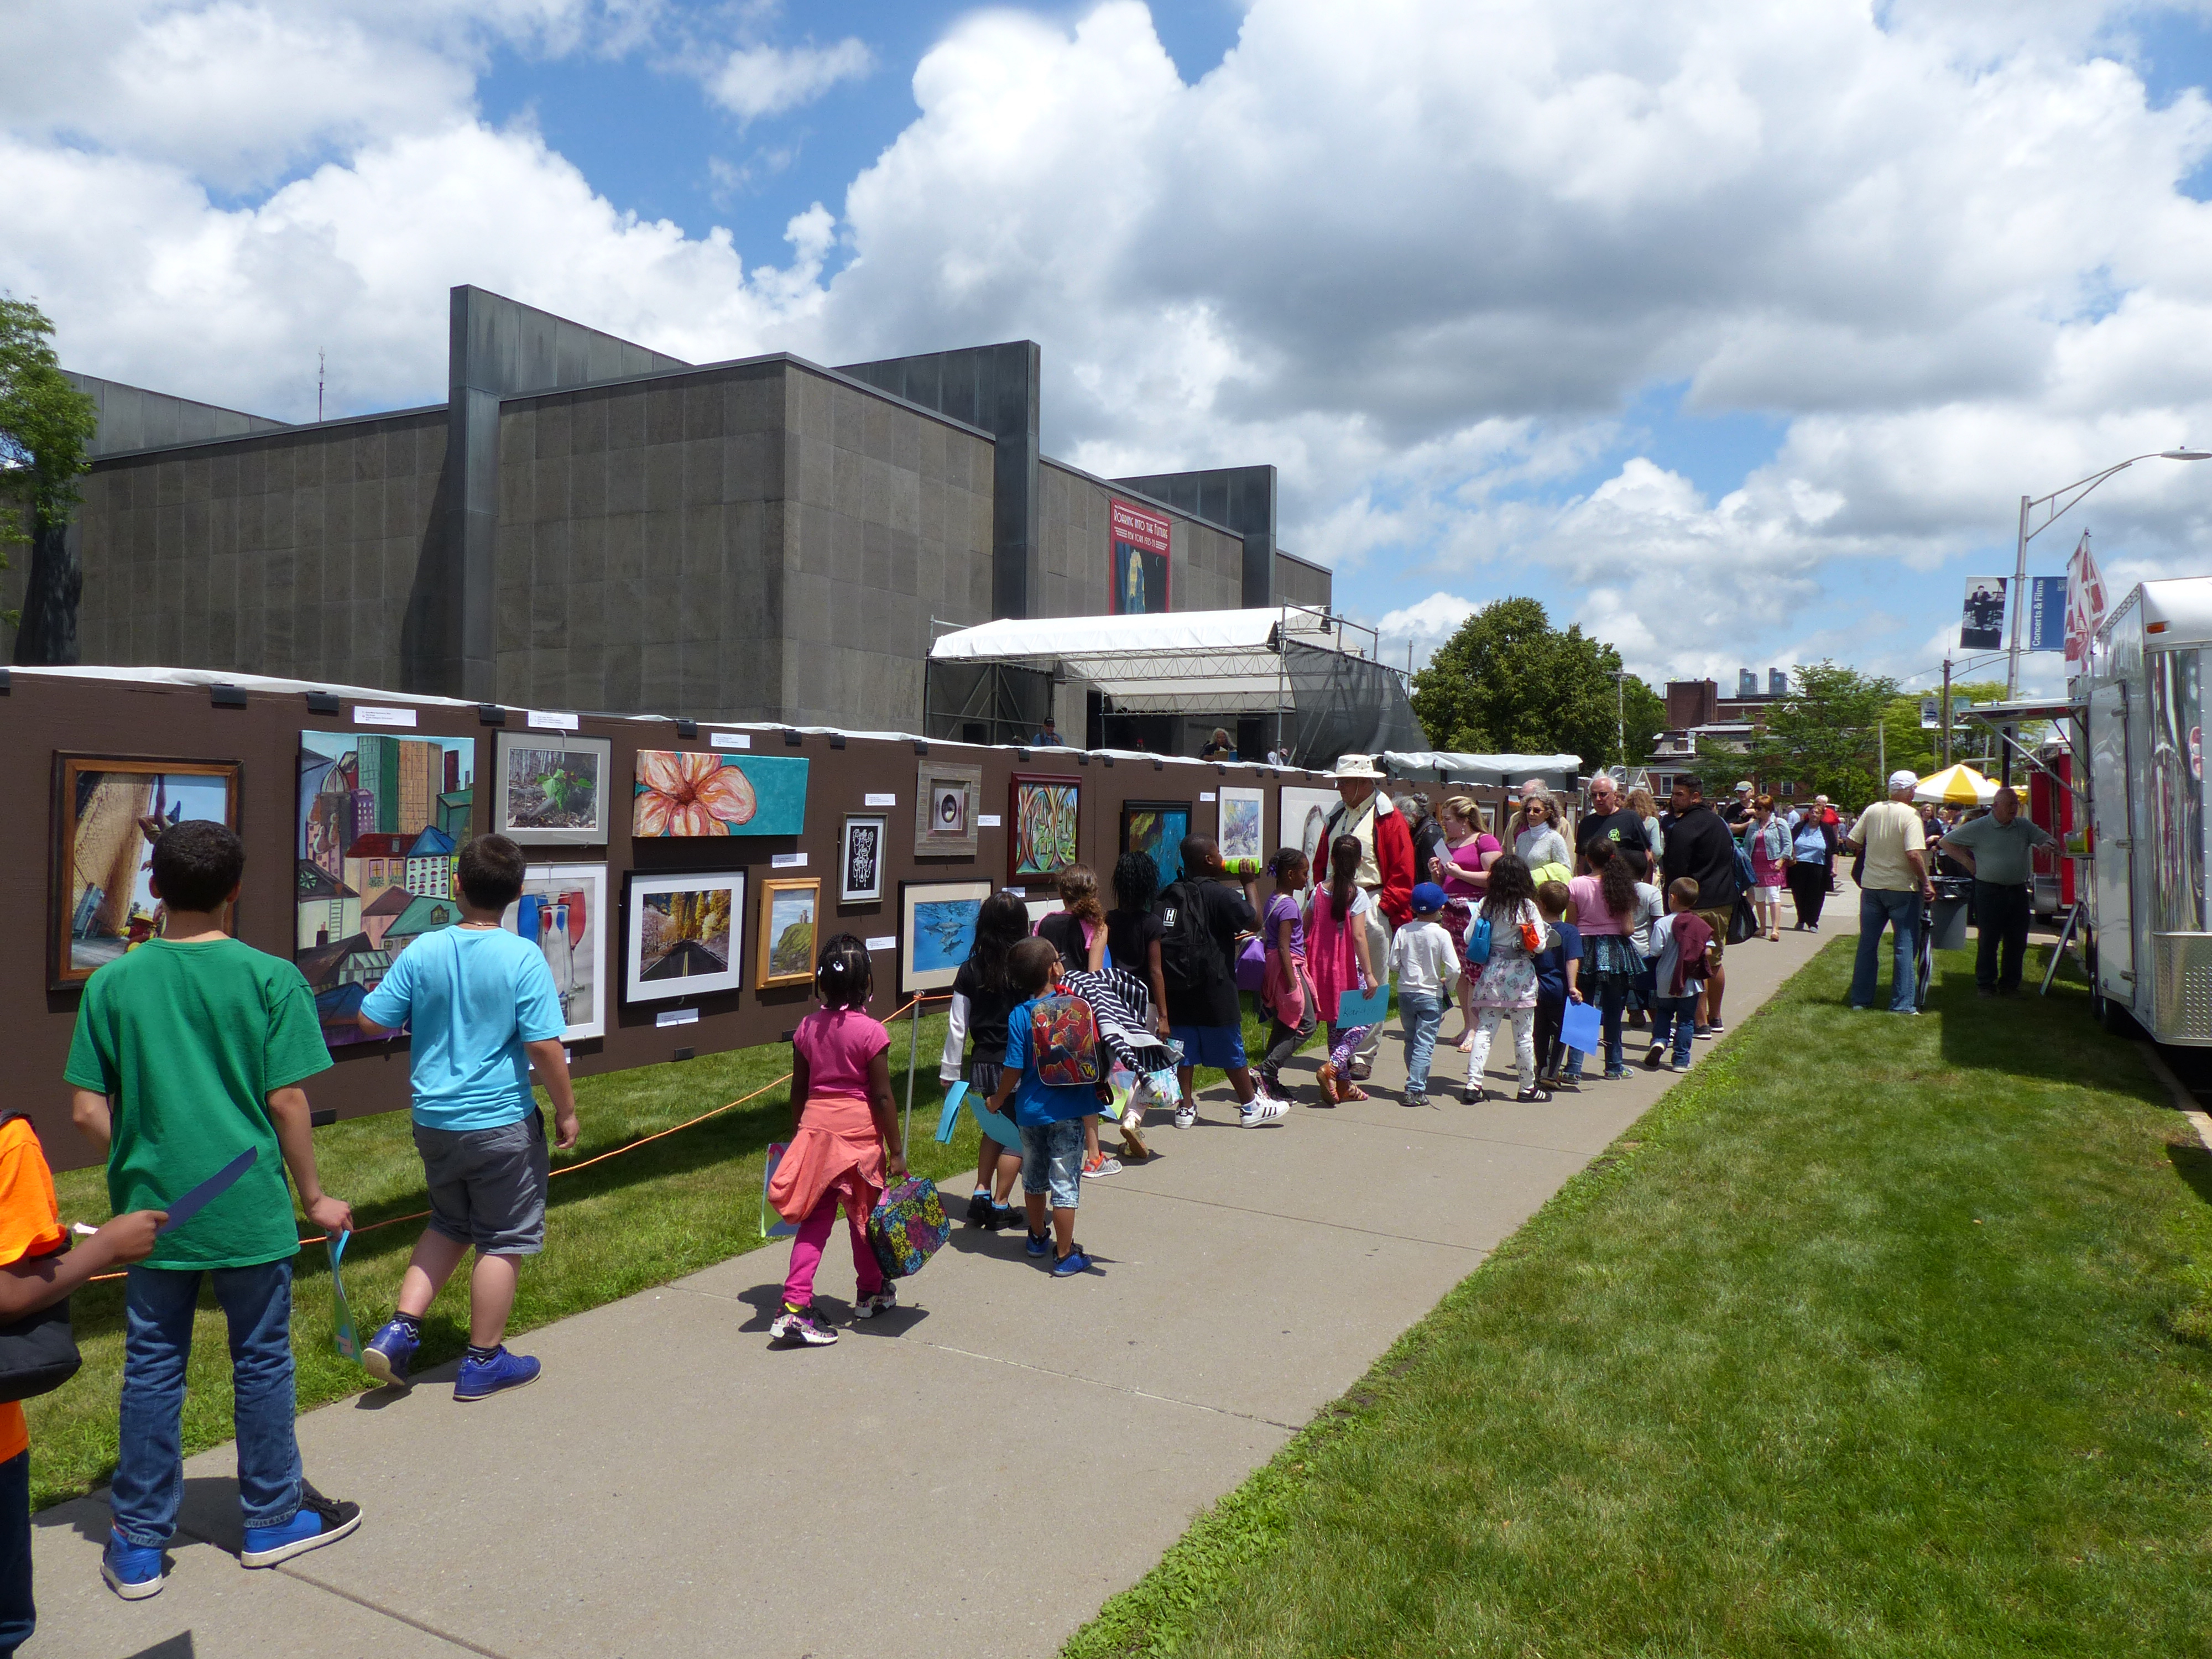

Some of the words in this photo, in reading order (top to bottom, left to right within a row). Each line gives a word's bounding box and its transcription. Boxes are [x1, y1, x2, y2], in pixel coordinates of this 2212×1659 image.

[1114, 509, 1134, 527] ROARING
[1135, 519, 1145, 531] INTO
[1154, 523, 1168, 539] FUTURE
[1135, 534, 1144, 543] YORK
[2034, 580, 2044, 602] Films
[2032, 610, 2042, 646] Concerts
[1166, 909, 1175, 921] H
